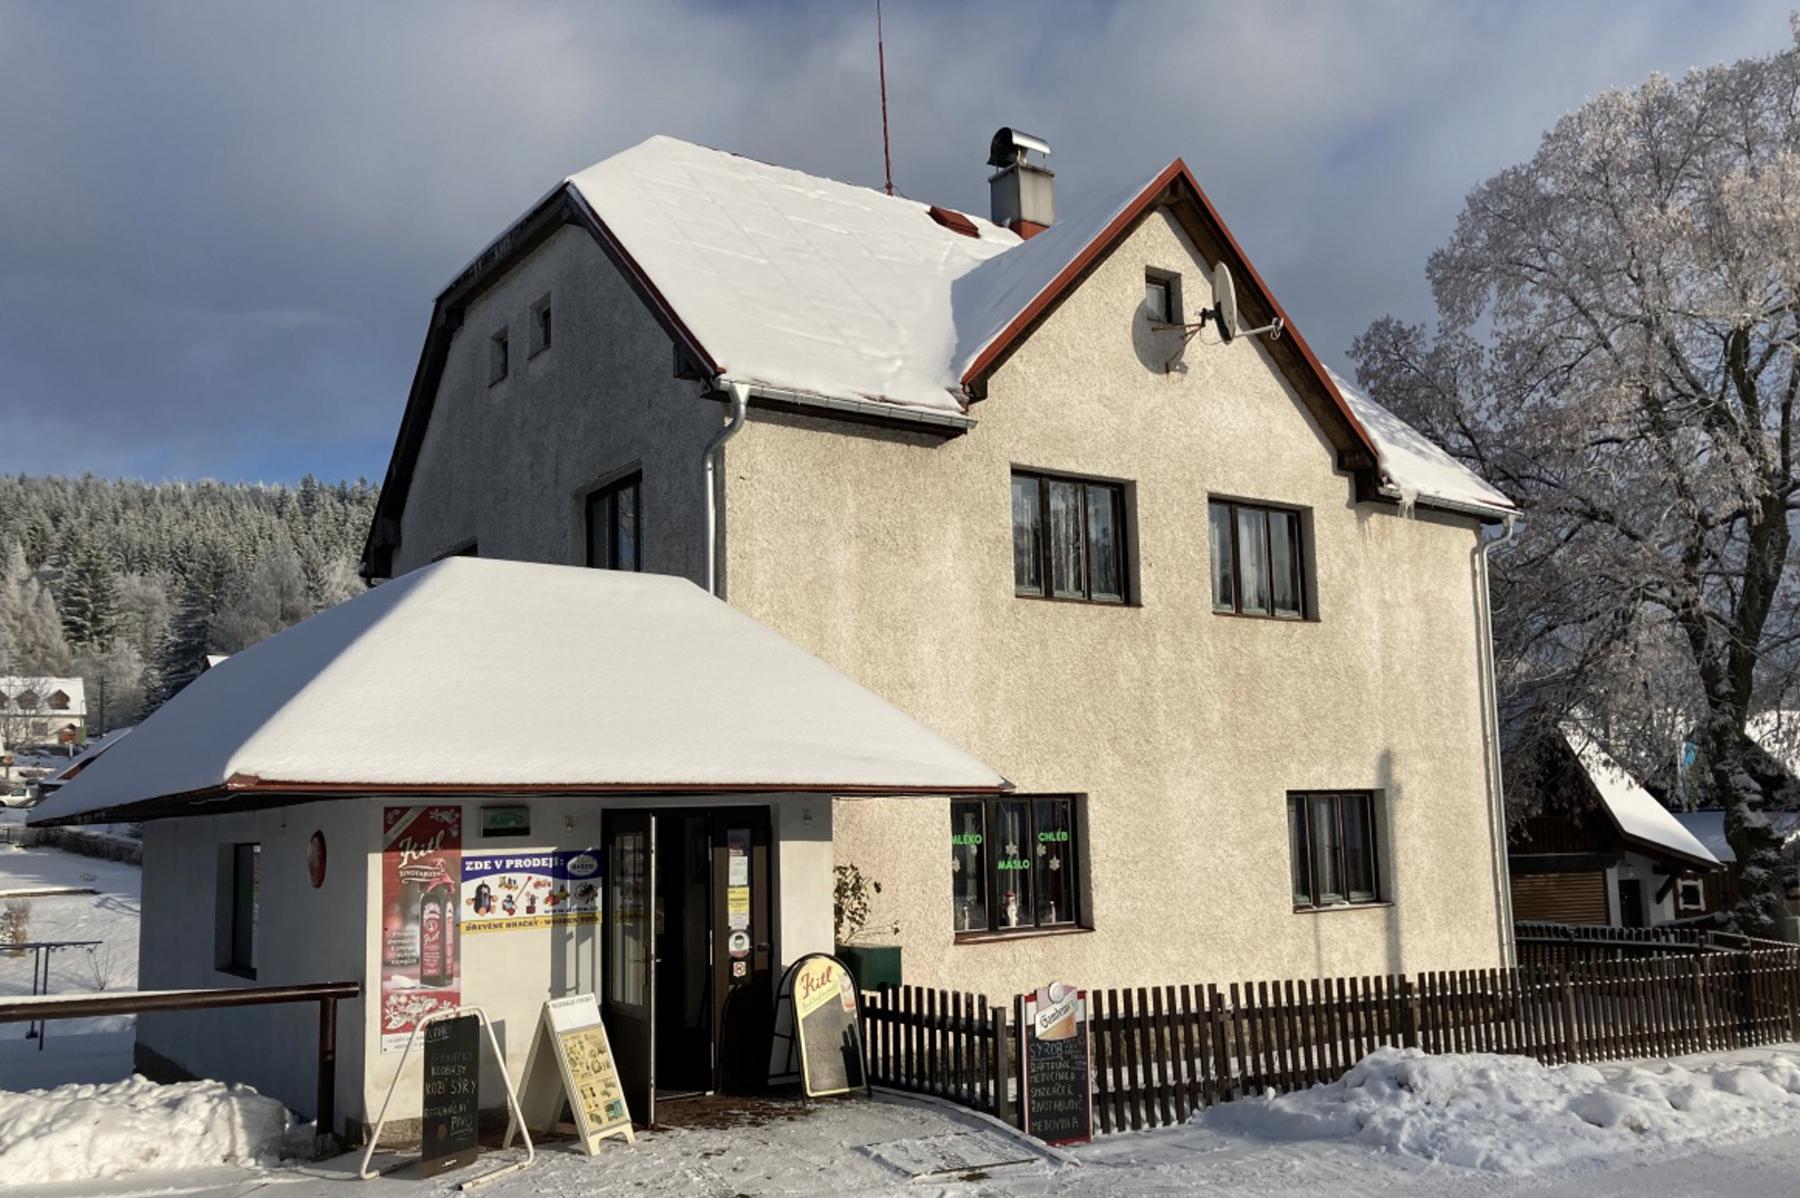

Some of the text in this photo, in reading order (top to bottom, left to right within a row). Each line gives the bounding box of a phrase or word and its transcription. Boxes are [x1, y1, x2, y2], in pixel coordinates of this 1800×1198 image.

[951, 832, 982, 845] MLÉKO
[1038, 828, 1068, 842] CHLÉB
[398, 829, 445, 869] Kitl
[465, 860, 491, 871] ZDE
[494, 859, 503, 869] V
[801, 965, 832, 1000] Kitl
